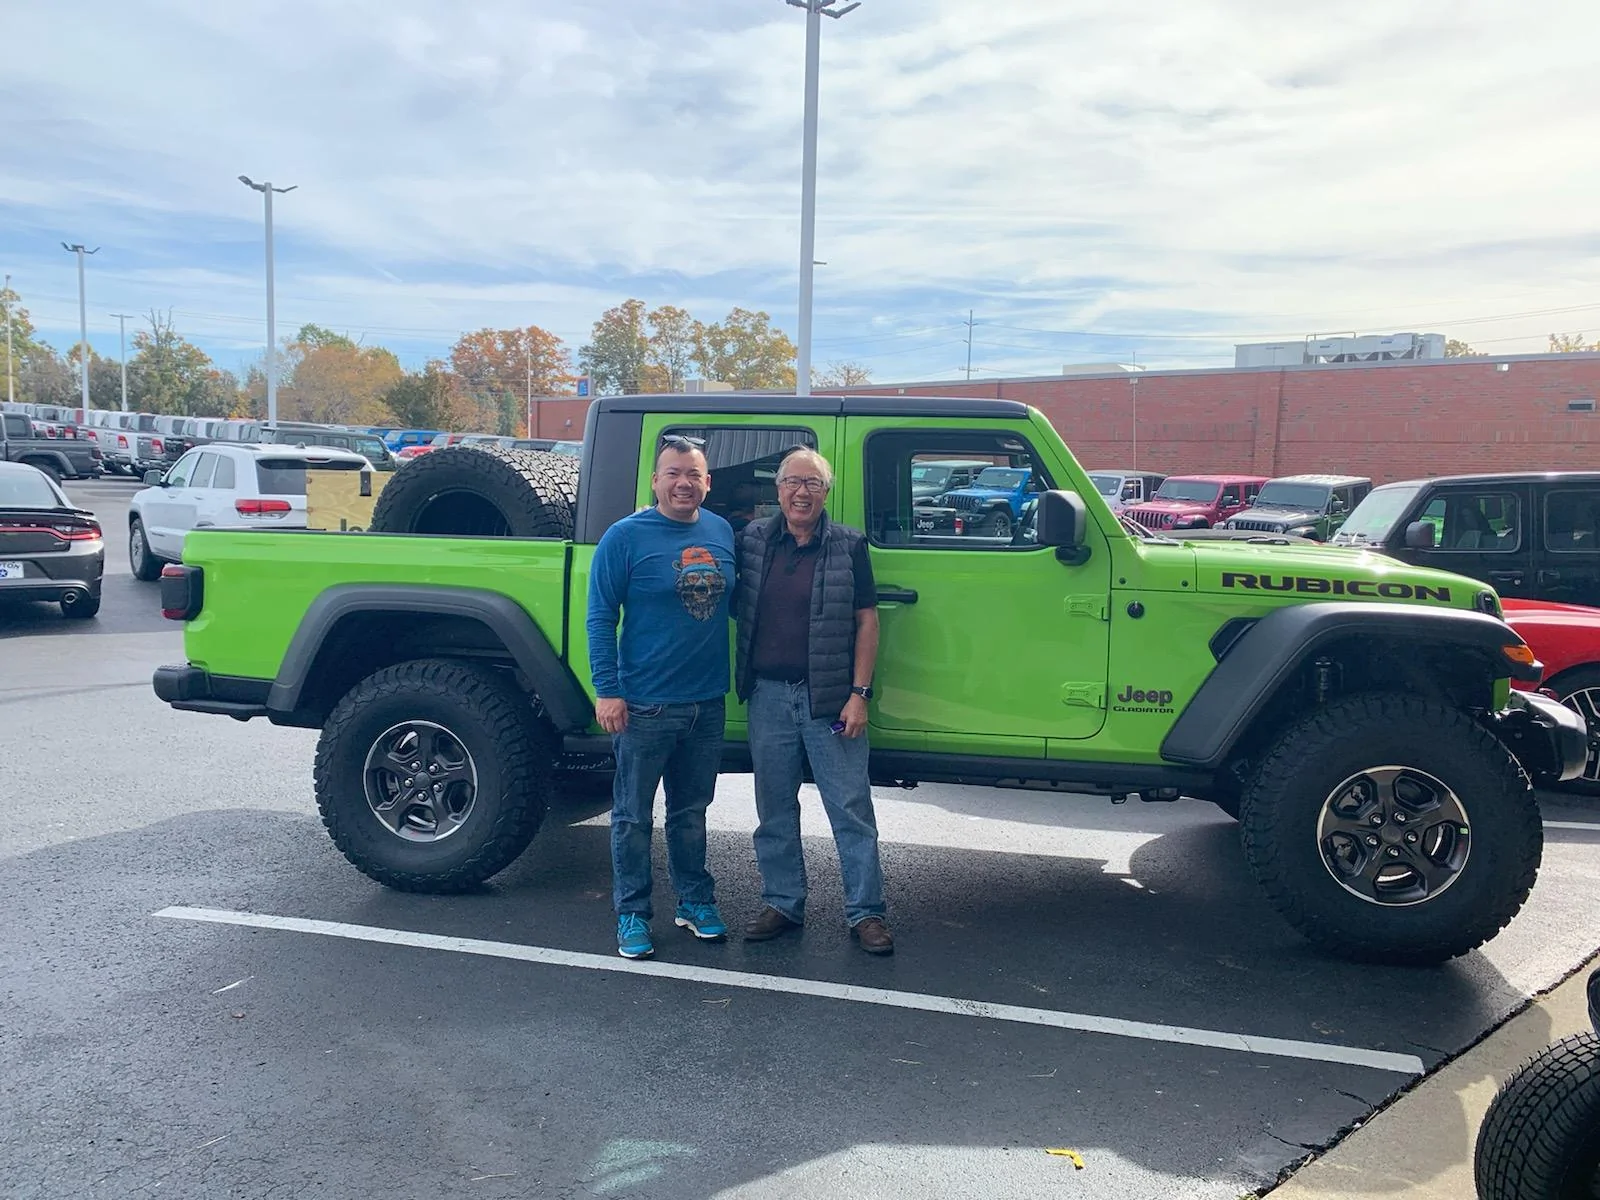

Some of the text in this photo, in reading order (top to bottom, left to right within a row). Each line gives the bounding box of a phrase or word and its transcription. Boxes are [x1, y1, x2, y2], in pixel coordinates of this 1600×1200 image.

[1222, 572, 1451, 602] RUBICON
[1117, 685, 1173, 706] Jeep
[1113, 705, 1174, 714] GLADIATOR
